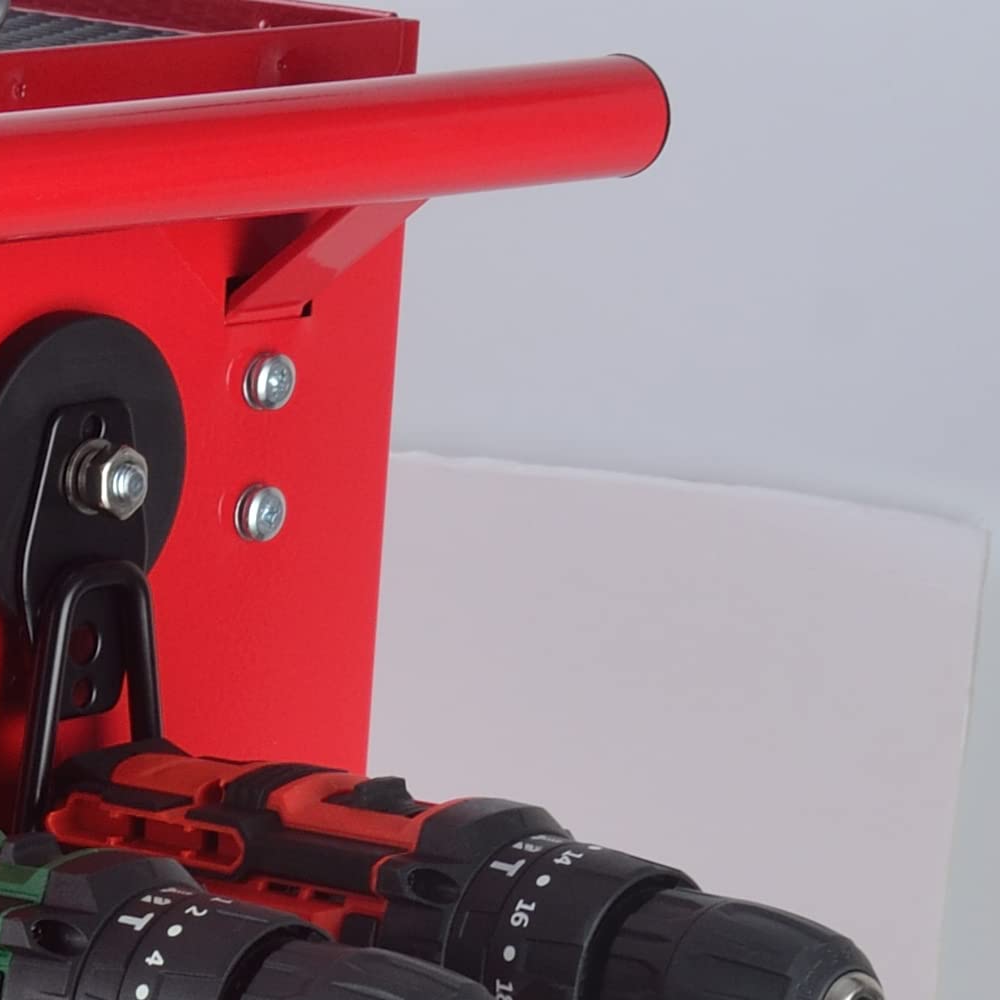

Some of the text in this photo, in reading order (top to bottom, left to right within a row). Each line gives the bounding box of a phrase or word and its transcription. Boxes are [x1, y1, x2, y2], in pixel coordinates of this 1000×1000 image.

[553, 850, 583, 865] 14
[510, 899, 536, 928] 16
[145, 950, 164, 966] 4
